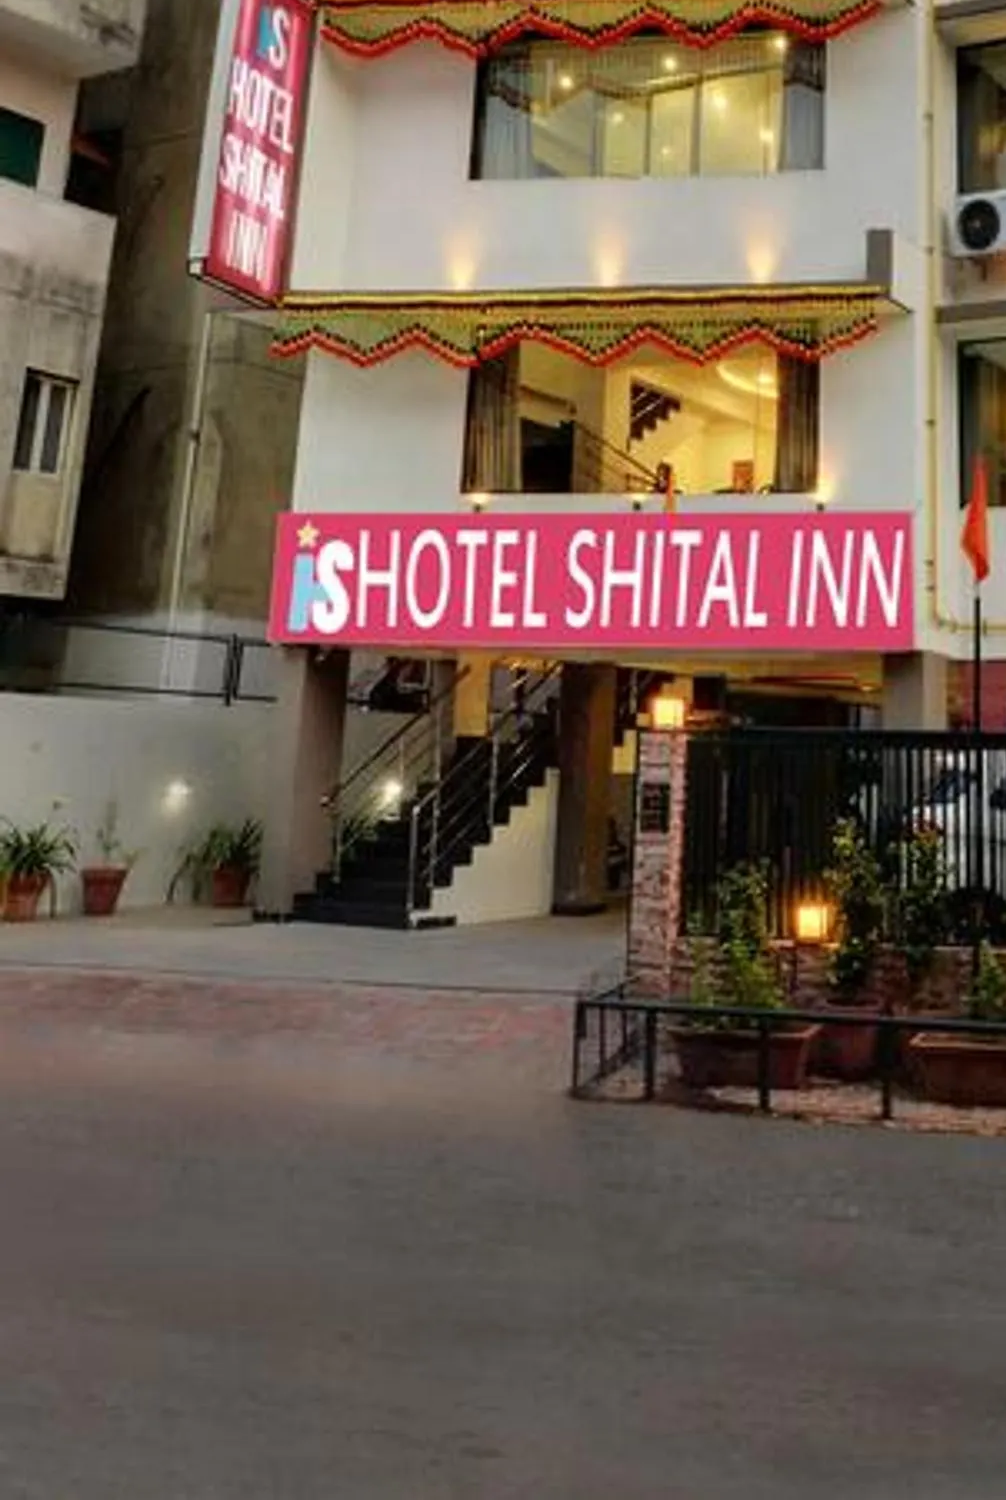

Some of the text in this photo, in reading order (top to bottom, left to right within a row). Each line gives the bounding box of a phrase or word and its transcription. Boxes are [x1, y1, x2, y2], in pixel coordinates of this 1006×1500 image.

[229, 56, 295, 155] HOTEL
[219, 133, 286, 221] SHITAL
[225, 208, 269, 282] INN
[355, 528, 549, 629] HOTEL
[564, 528, 768, 629] SHITAL
[786, 528, 905, 629] INN
